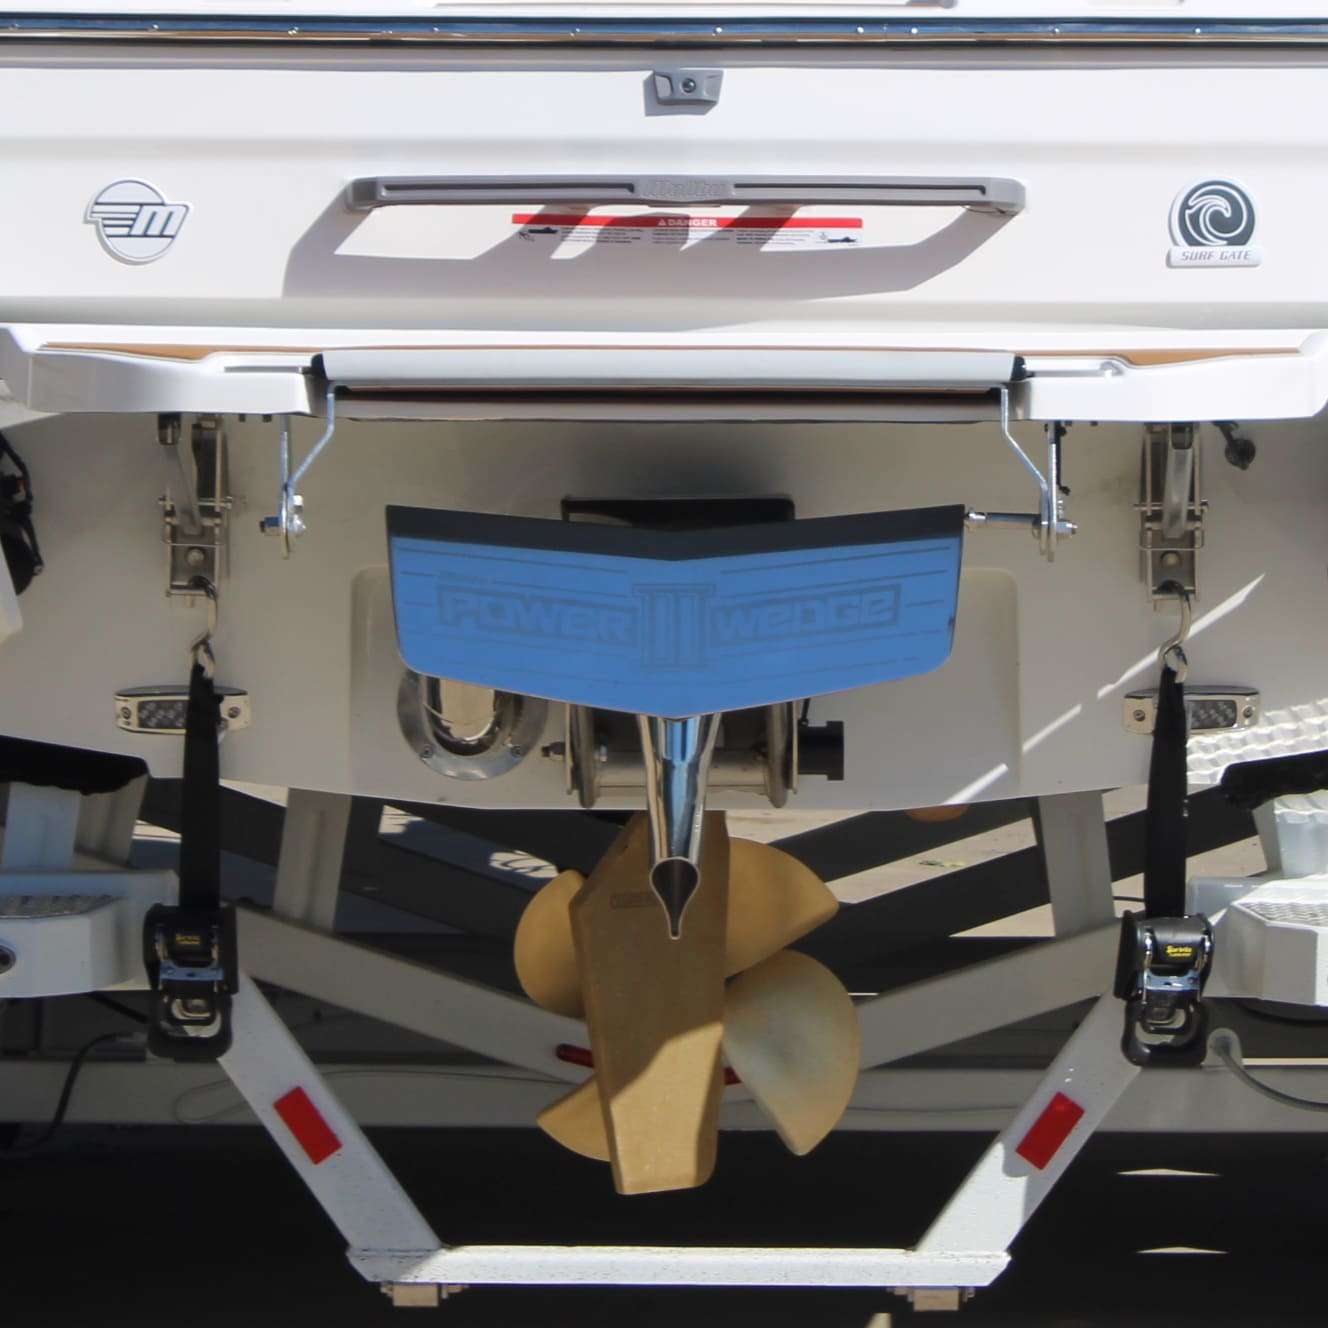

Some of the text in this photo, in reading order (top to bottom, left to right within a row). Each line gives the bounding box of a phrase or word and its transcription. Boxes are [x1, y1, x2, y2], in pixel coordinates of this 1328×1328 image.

[667, 218, 718, 227] DANGER
[1180, 249, 1253, 262] SURF GATE
